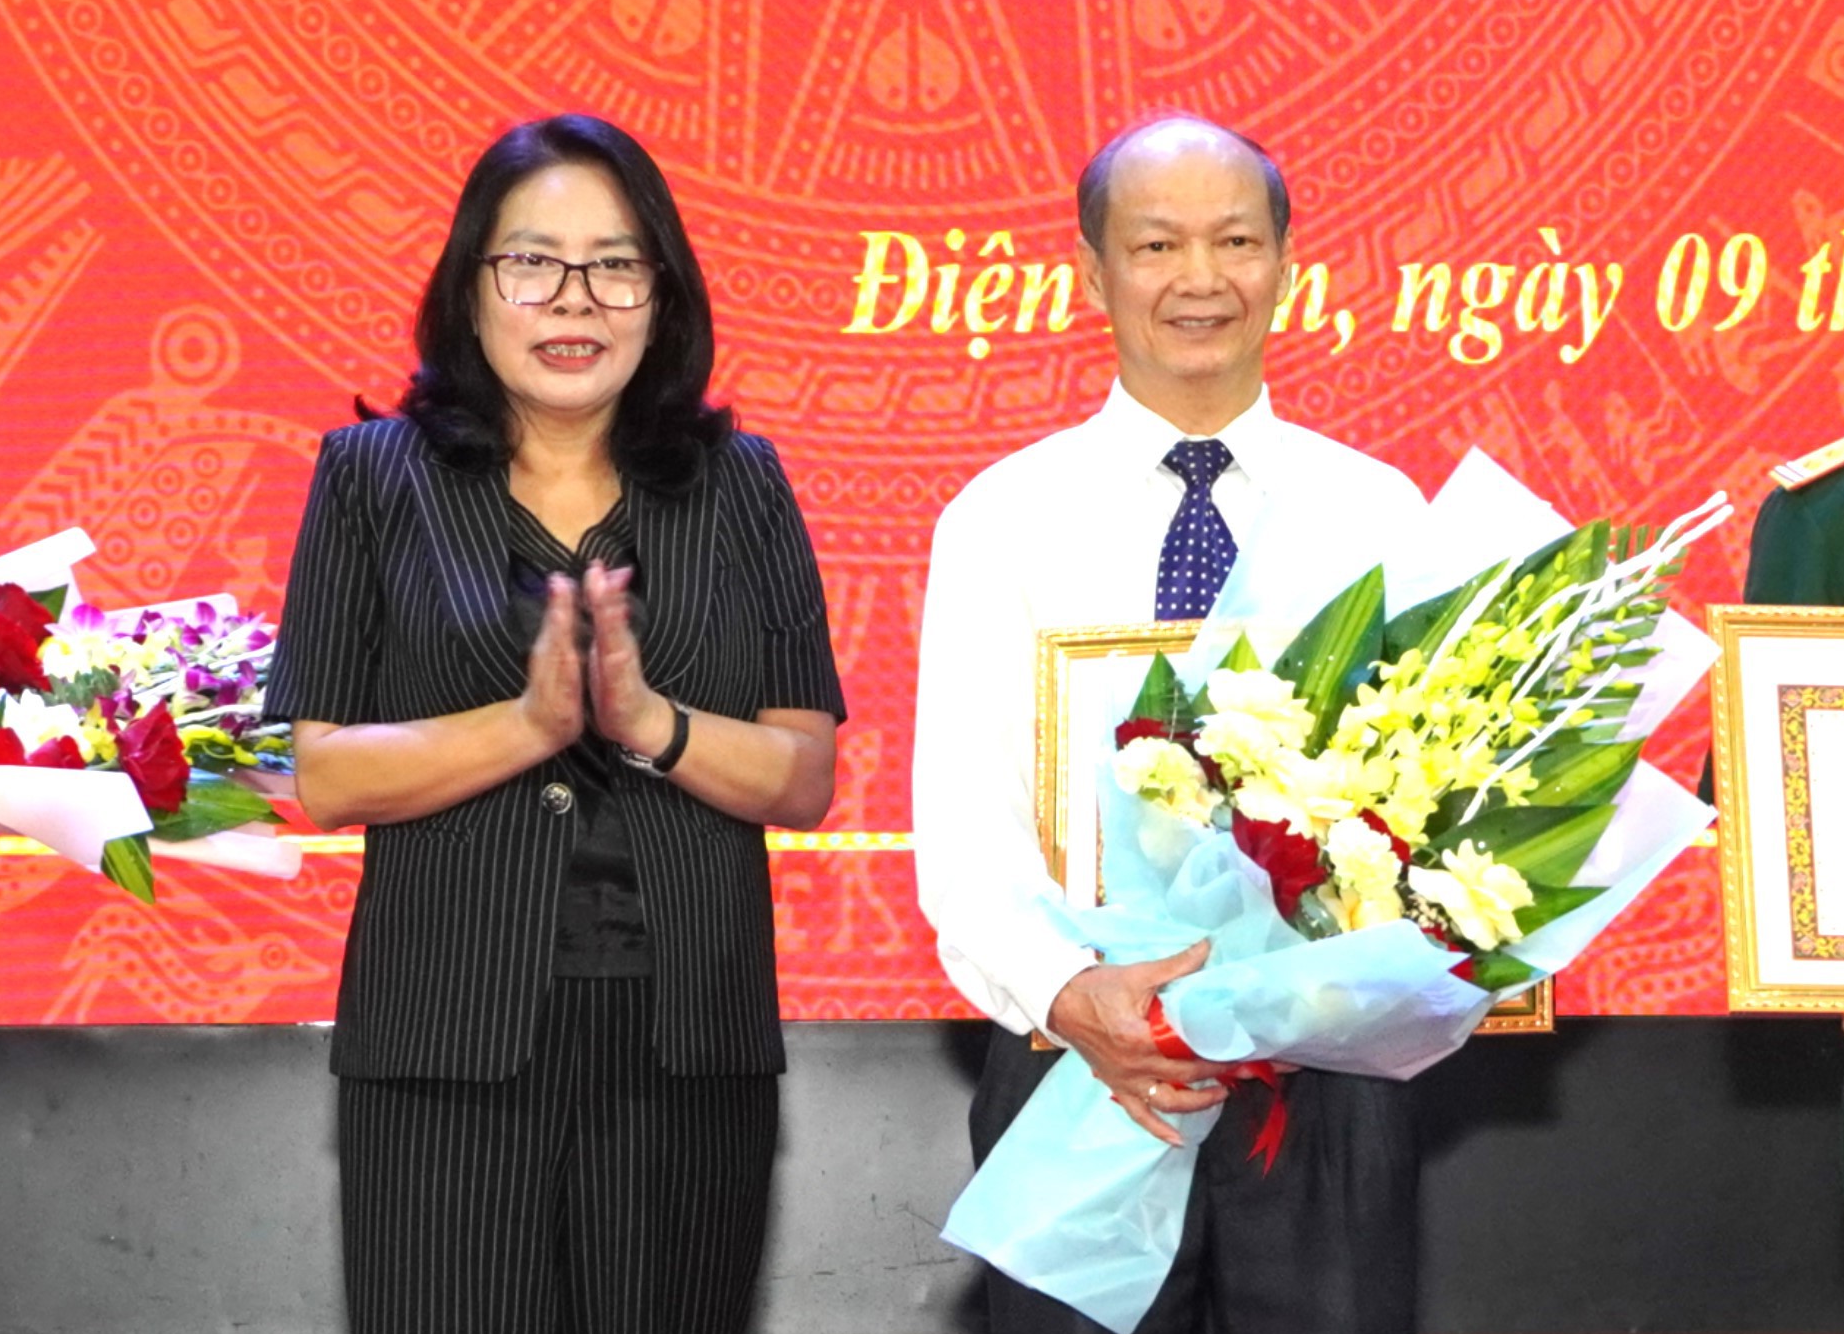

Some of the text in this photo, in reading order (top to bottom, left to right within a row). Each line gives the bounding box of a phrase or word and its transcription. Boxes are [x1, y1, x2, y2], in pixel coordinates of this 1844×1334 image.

[840, 228, 1076, 360] Điện
[1390, 226, 1624, 365] ngày
[1656, 232, 1768, 333] 09
